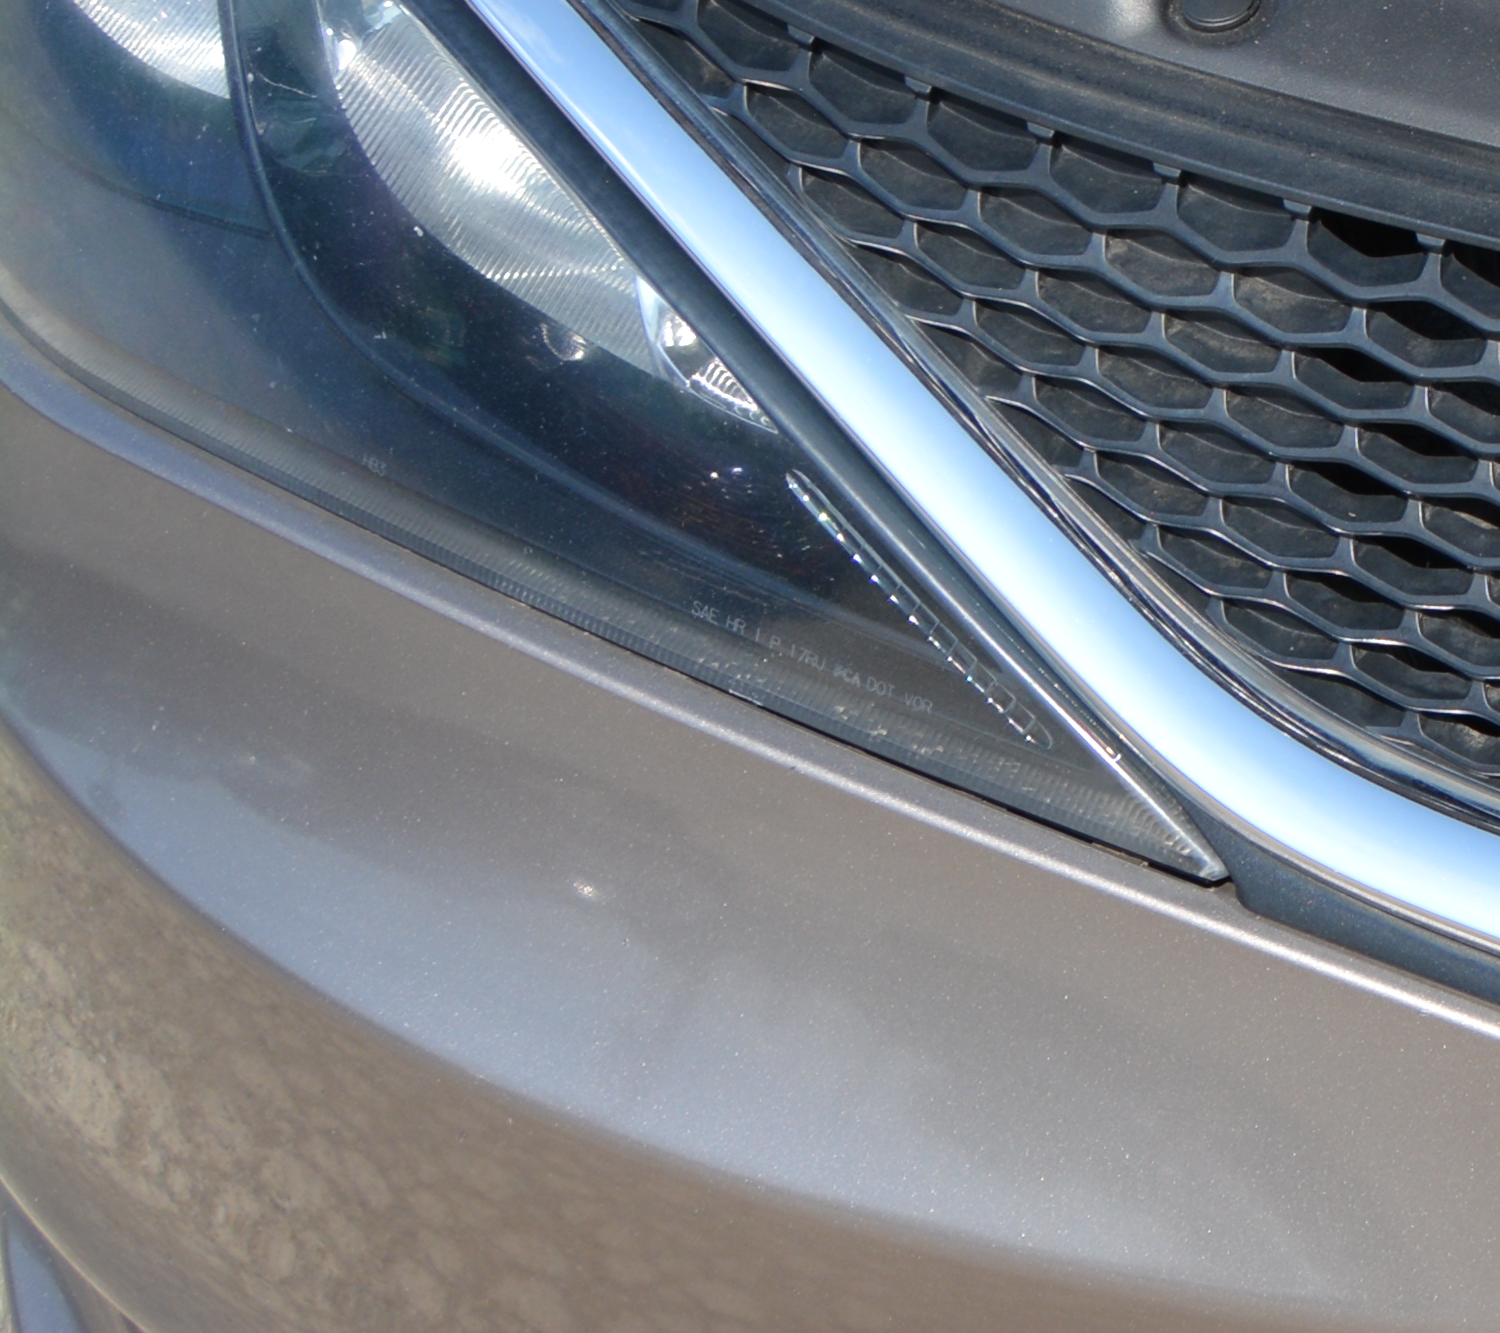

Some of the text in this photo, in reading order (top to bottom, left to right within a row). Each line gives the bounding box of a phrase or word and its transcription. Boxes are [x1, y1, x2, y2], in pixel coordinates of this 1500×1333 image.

[691, 600, 719, 627] SAE
[725, 614, 746, 636] HR
[866, 676, 896, 697] DOT
[904, 692, 934, 715] VOR
